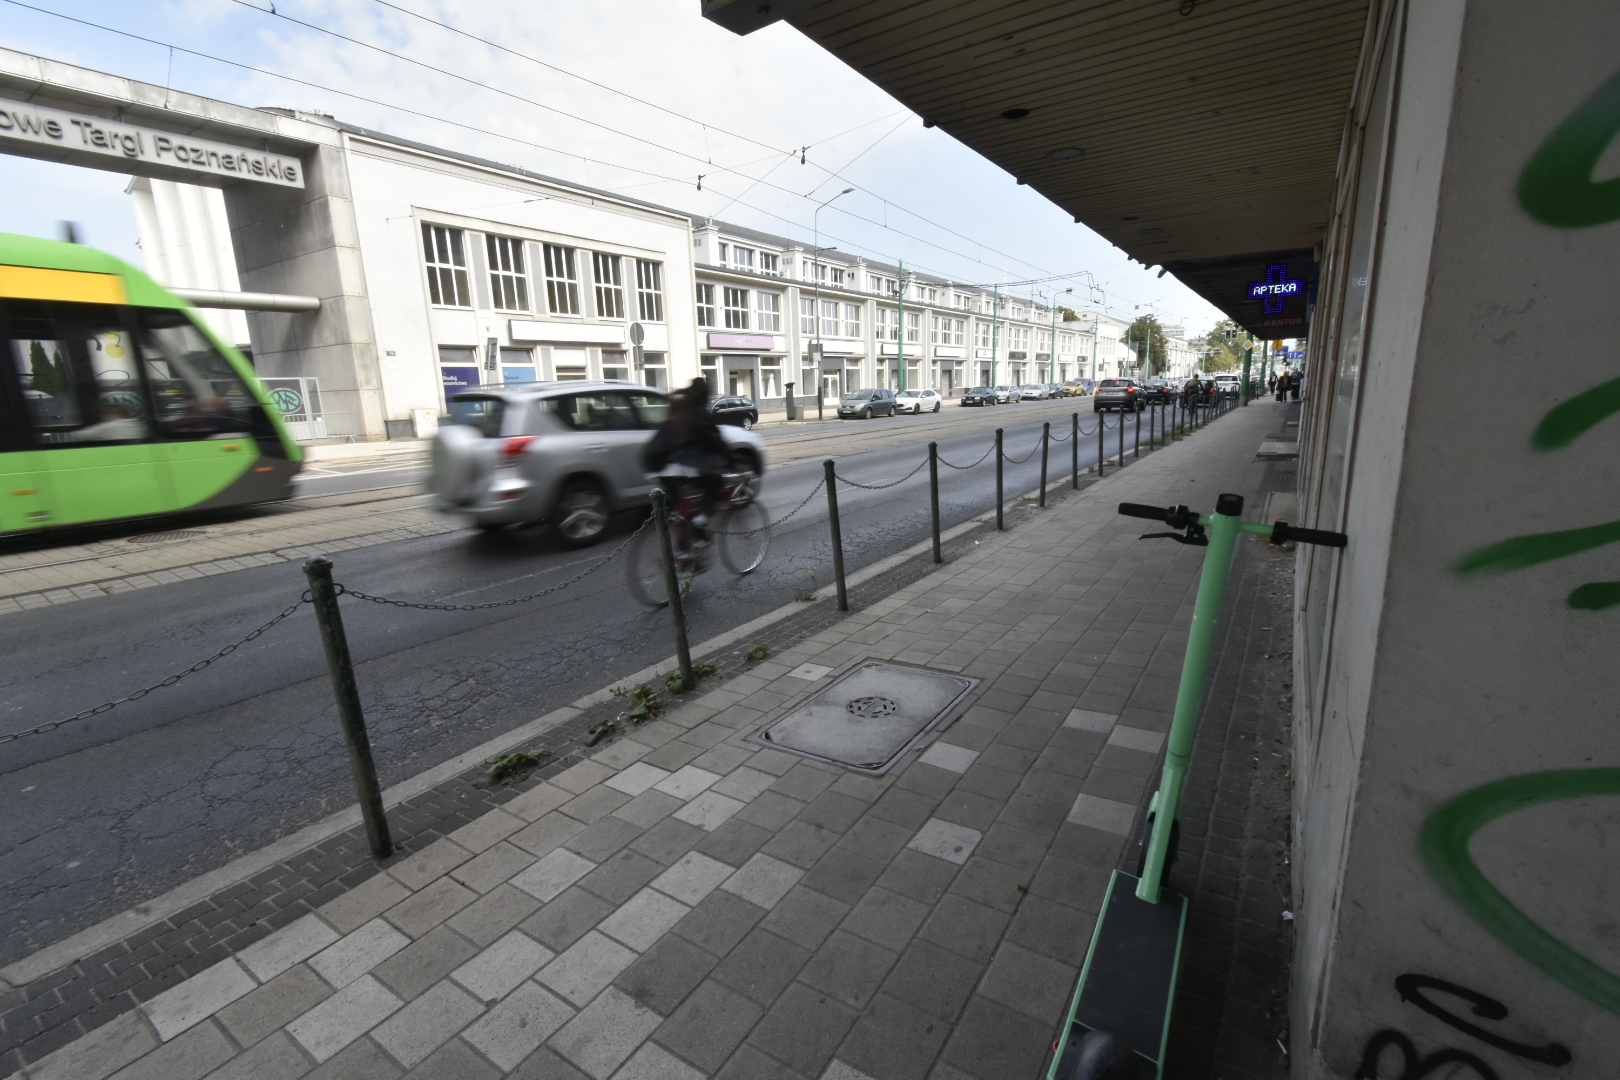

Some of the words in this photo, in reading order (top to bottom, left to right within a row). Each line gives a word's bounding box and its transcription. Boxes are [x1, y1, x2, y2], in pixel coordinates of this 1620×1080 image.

[70, 118, 144, 158] Targi
[153, 134, 298, 183] Poznańskie
[1253, 283, 1297, 296] APTEKA
[1263, 317, 1303, 327] KANTOR
